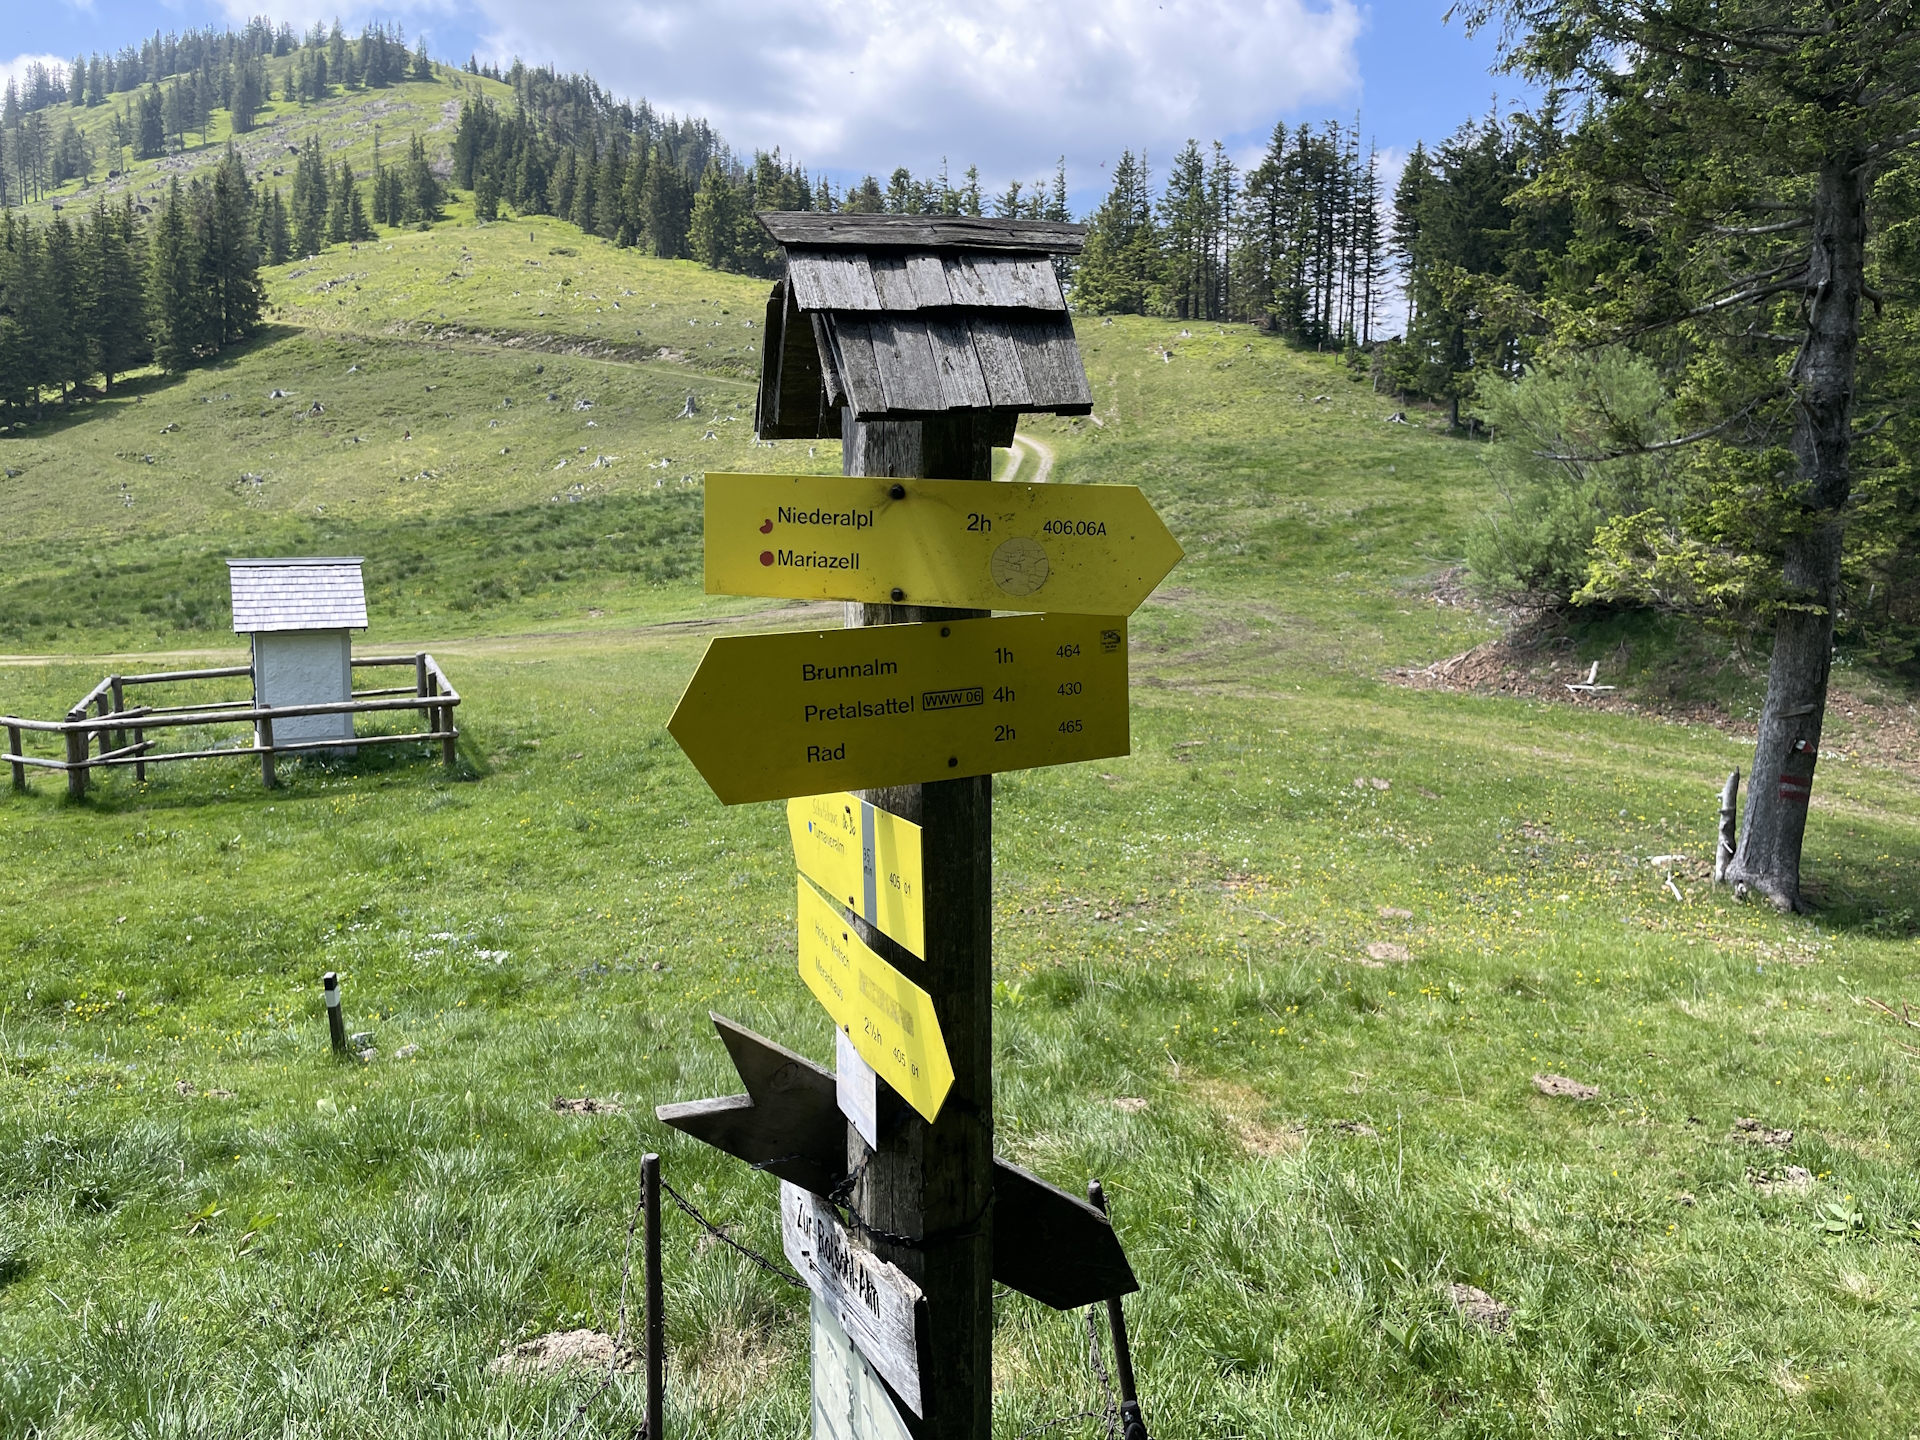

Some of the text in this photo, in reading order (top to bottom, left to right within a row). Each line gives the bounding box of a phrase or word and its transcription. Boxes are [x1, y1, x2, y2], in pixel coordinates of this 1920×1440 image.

[777, 506, 874, 531] Niederalpl
[966, 513, 992, 533] 2h
[777, 550, 861, 571] Mariazell
[802, 658, 898, 682] Brunnalm
[994, 647, 1014, 664] 1h
[1055, 644, 1082, 658] 464
[804, 682, 1083, 723] Pretalsattel WWW 06 4h 430
[806, 719, 1083, 763] Rad 2h 465
[889, 872, 901, 890] 405
[815, 919, 850, 971] Hohe Veitsch
[893, 1047, 906, 1067] 405
[911, 1063, 919, 1078] 01
[797, 1196, 812, 1242] Zur
